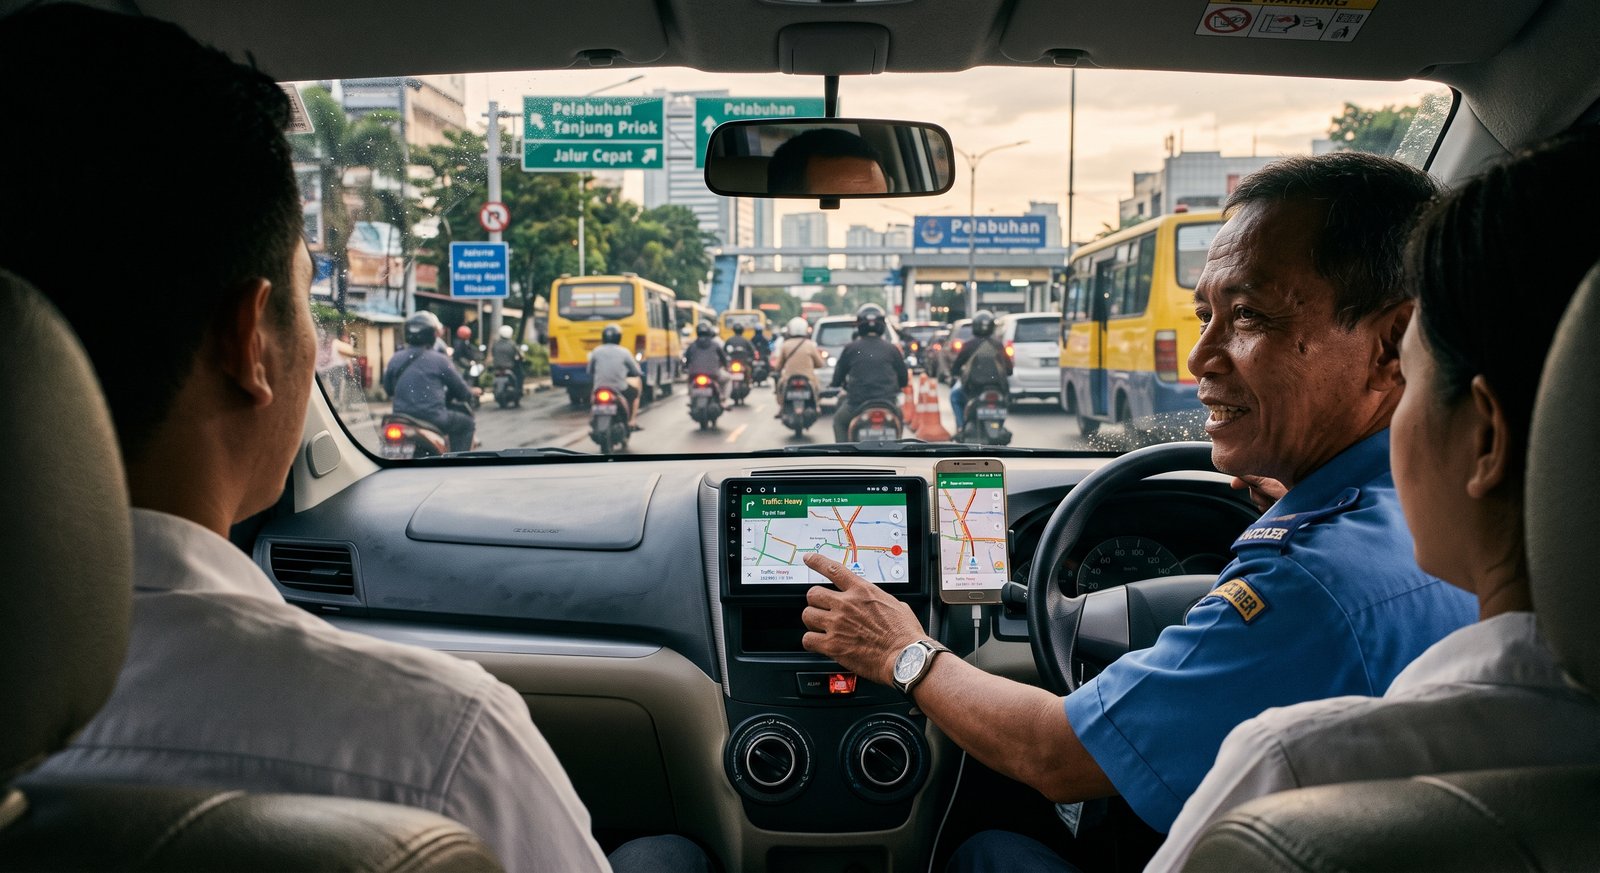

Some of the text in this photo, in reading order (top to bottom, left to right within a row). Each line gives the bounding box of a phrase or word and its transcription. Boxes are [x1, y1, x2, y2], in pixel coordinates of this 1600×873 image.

[552, 102, 632, 116] Pelabuhan
[724, 102, 796, 115] Pelabuhan
[553, 120, 657, 137] Tanjung Priok
[554, 148, 632, 165] Jalur Cepat
[951, 219, 1040, 234] Pelabuhan
[784, 498, 803, 506] Heavy
[1100, 556, 1111, 564] 60
[1147, 556, 1160, 564] 120
[1088, 582, 1099, 590] 20
